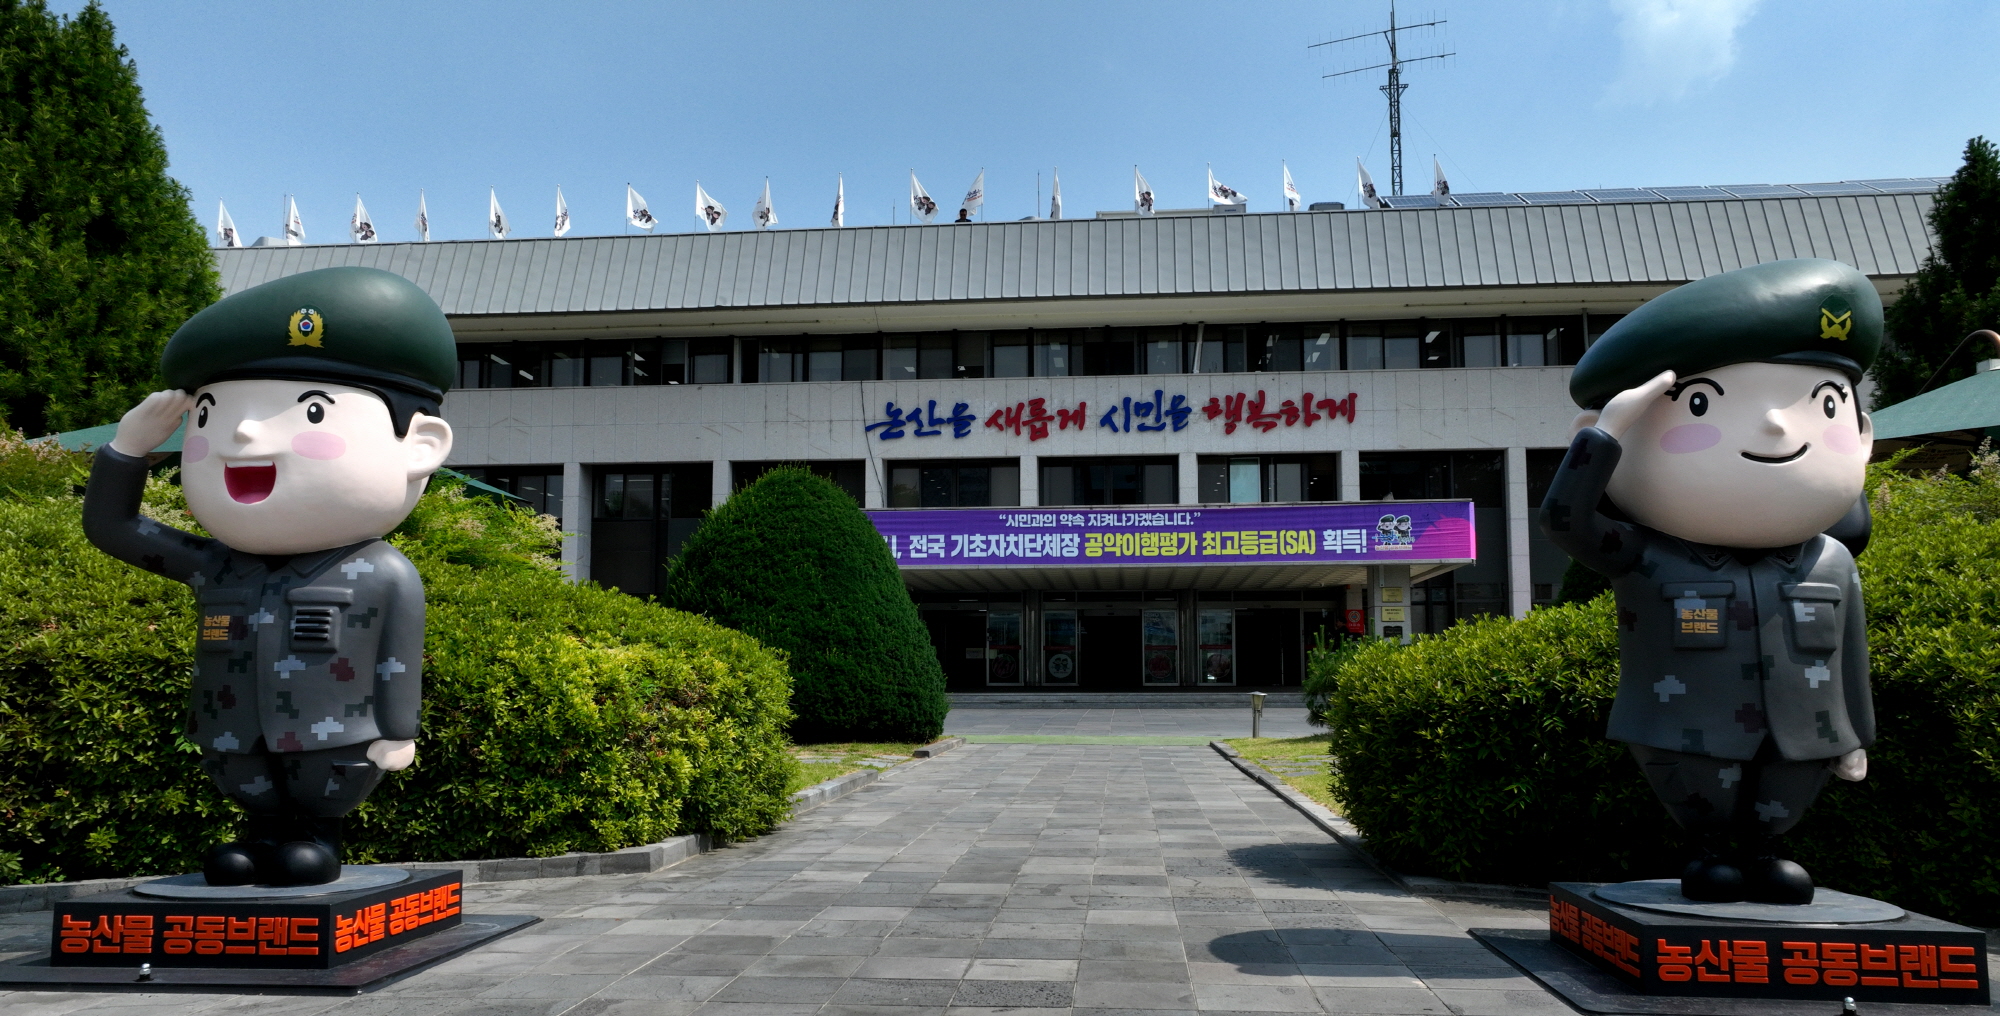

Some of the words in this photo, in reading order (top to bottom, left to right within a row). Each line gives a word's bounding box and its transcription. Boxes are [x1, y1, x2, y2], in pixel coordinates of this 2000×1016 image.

[865, 399, 976, 441] 논산을
[985, 397, 1087, 442] 새롭게
[1100, 389, 1193, 433] 시민을
[1202, 389, 1358, 435] 행복하게
[1060, 513, 1085, 527] 약속
[909, 533, 946, 559] 전국
[950, 532, 1081, 558] 기초자치단체장
[1084, 531, 1199, 557] 공약이행평가
[1202, 529, 1316, 556] 최고등급(SA)
[1322, 528, 1367, 554] 획득!
[204, 615, 231, 627] 농산물
[1681, 608, 1719, 620] 농산물
[1681, 621, 1719, 634] 브랜드
[202, 628, 229, 641] 브랜드
[334, 902, 387, 954] 농산물
[389, 882, 461, 936] 공동브랜드
[60, 914, 155, 955] 농산물
[163, 914, 320, 956] 공동브랜드
[1550, 894, 1579, 943] 농산물
[1580, 910, 1641, 978] 공동브랜드
[1656, 938, 1770, 984] 농산물
[1782, 940, 1979, 990] 공동브랜드
